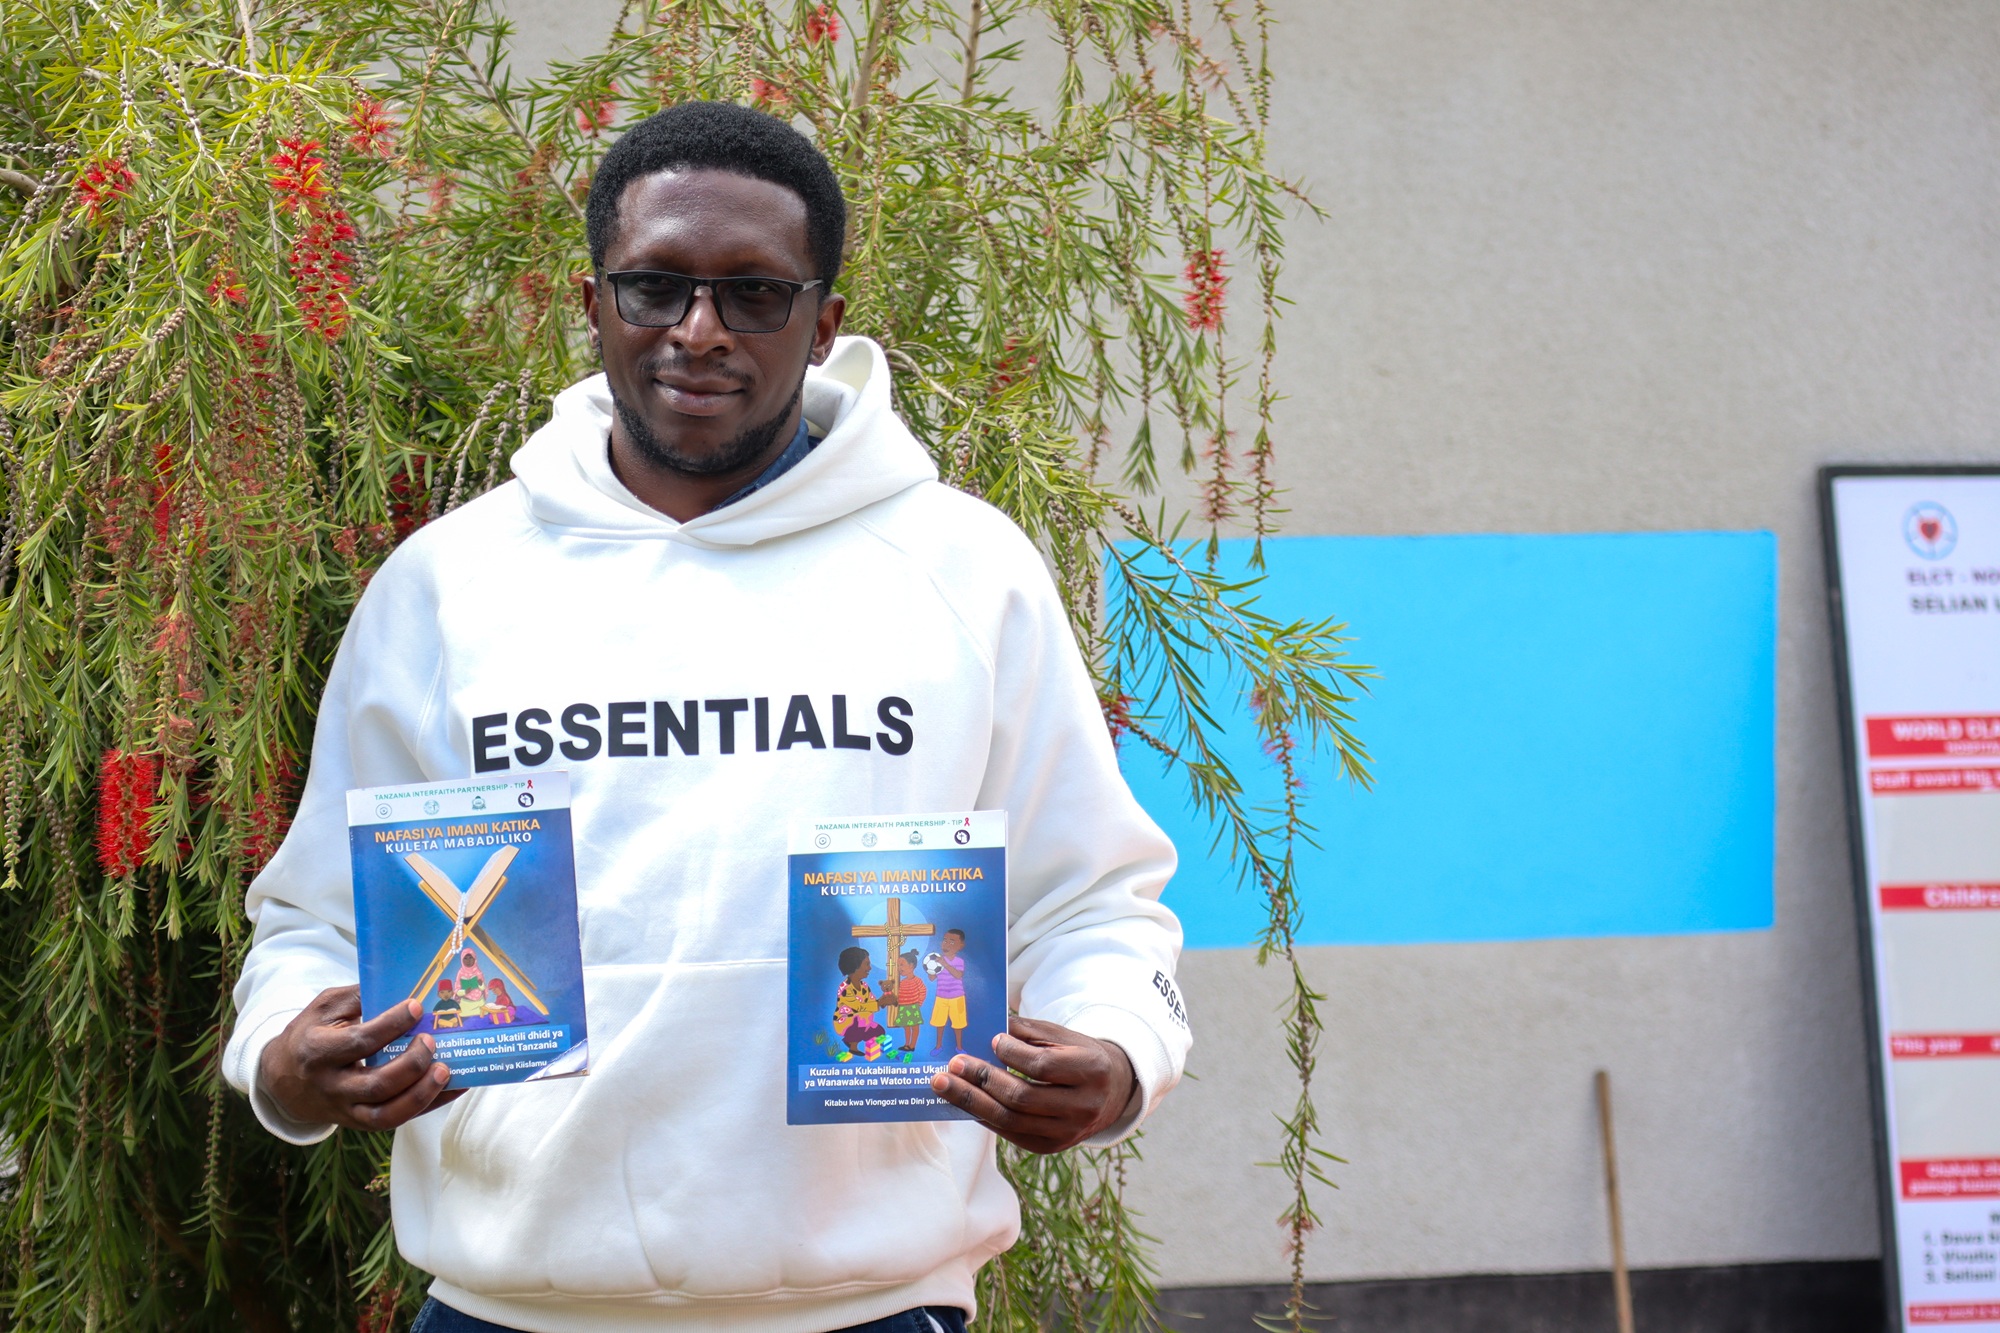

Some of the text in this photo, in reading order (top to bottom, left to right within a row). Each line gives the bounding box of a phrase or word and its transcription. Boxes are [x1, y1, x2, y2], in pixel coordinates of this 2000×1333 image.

[1972, 567, 2000, 585] NO
[1911, 595, 1987, 614] SELIAN
[472, 694, 914, 774] ESSENTIALS
[1892, 719, 1963, 741] WORLD
[374, 791, 411, 801] TANZANIA
[412, 788, 456, 798] INTERFAITH
[457, 783, 508, 794] PARTNERSHIP
[514, 782, 525, 790] TIP
[374, 818, 541, 843] NAFASI YA IMANI KATIKA
[815, 823, 850, 831] TANZANIA
[851, 821, 894, 829] INTERFAITH
[895, 819, 946, 828] PARTNERSHIP
[385, 832, 532, 854] KULETA MABADILIKO
[804, 867, 984, 886] NAFASI YA IMANI KATIKA
[821, 881, 966, 896] KULETA MABADILIKO
[383, 1029, 564, 1053] Kuzui ukabiliana na Ukatili dhidi ya
[440, 1050, 452, 1059] na
[454, 1045, 485, 1058] Watoto
[487, 1043, 515, 1055] nchini
[516, 1041, 558, 1052] Tanzania
[449, 1059, 548, 1077] iongozi wa Dini ya Kiislamu
[810, 1064, 949, 1077] Kuzuia na Kukabiliana na Ukatil
[804, 1079, 816, 1089] ya
[817, 1076, 865, 1087] Wanawake
[866, 1078, 879, 1086] na
[880, 1076, 912, 1086] Watoto
[824, 1098, 848, 1108] Kitabu
[849, 1098, 864, 1107] kwa
[865, 1097, 897, 1108] Viongozi
[898, 1098, 909, 1106] wa
[910, 1097, 925, 1106] Dini
[926, 1098, 935, 1107] ya
